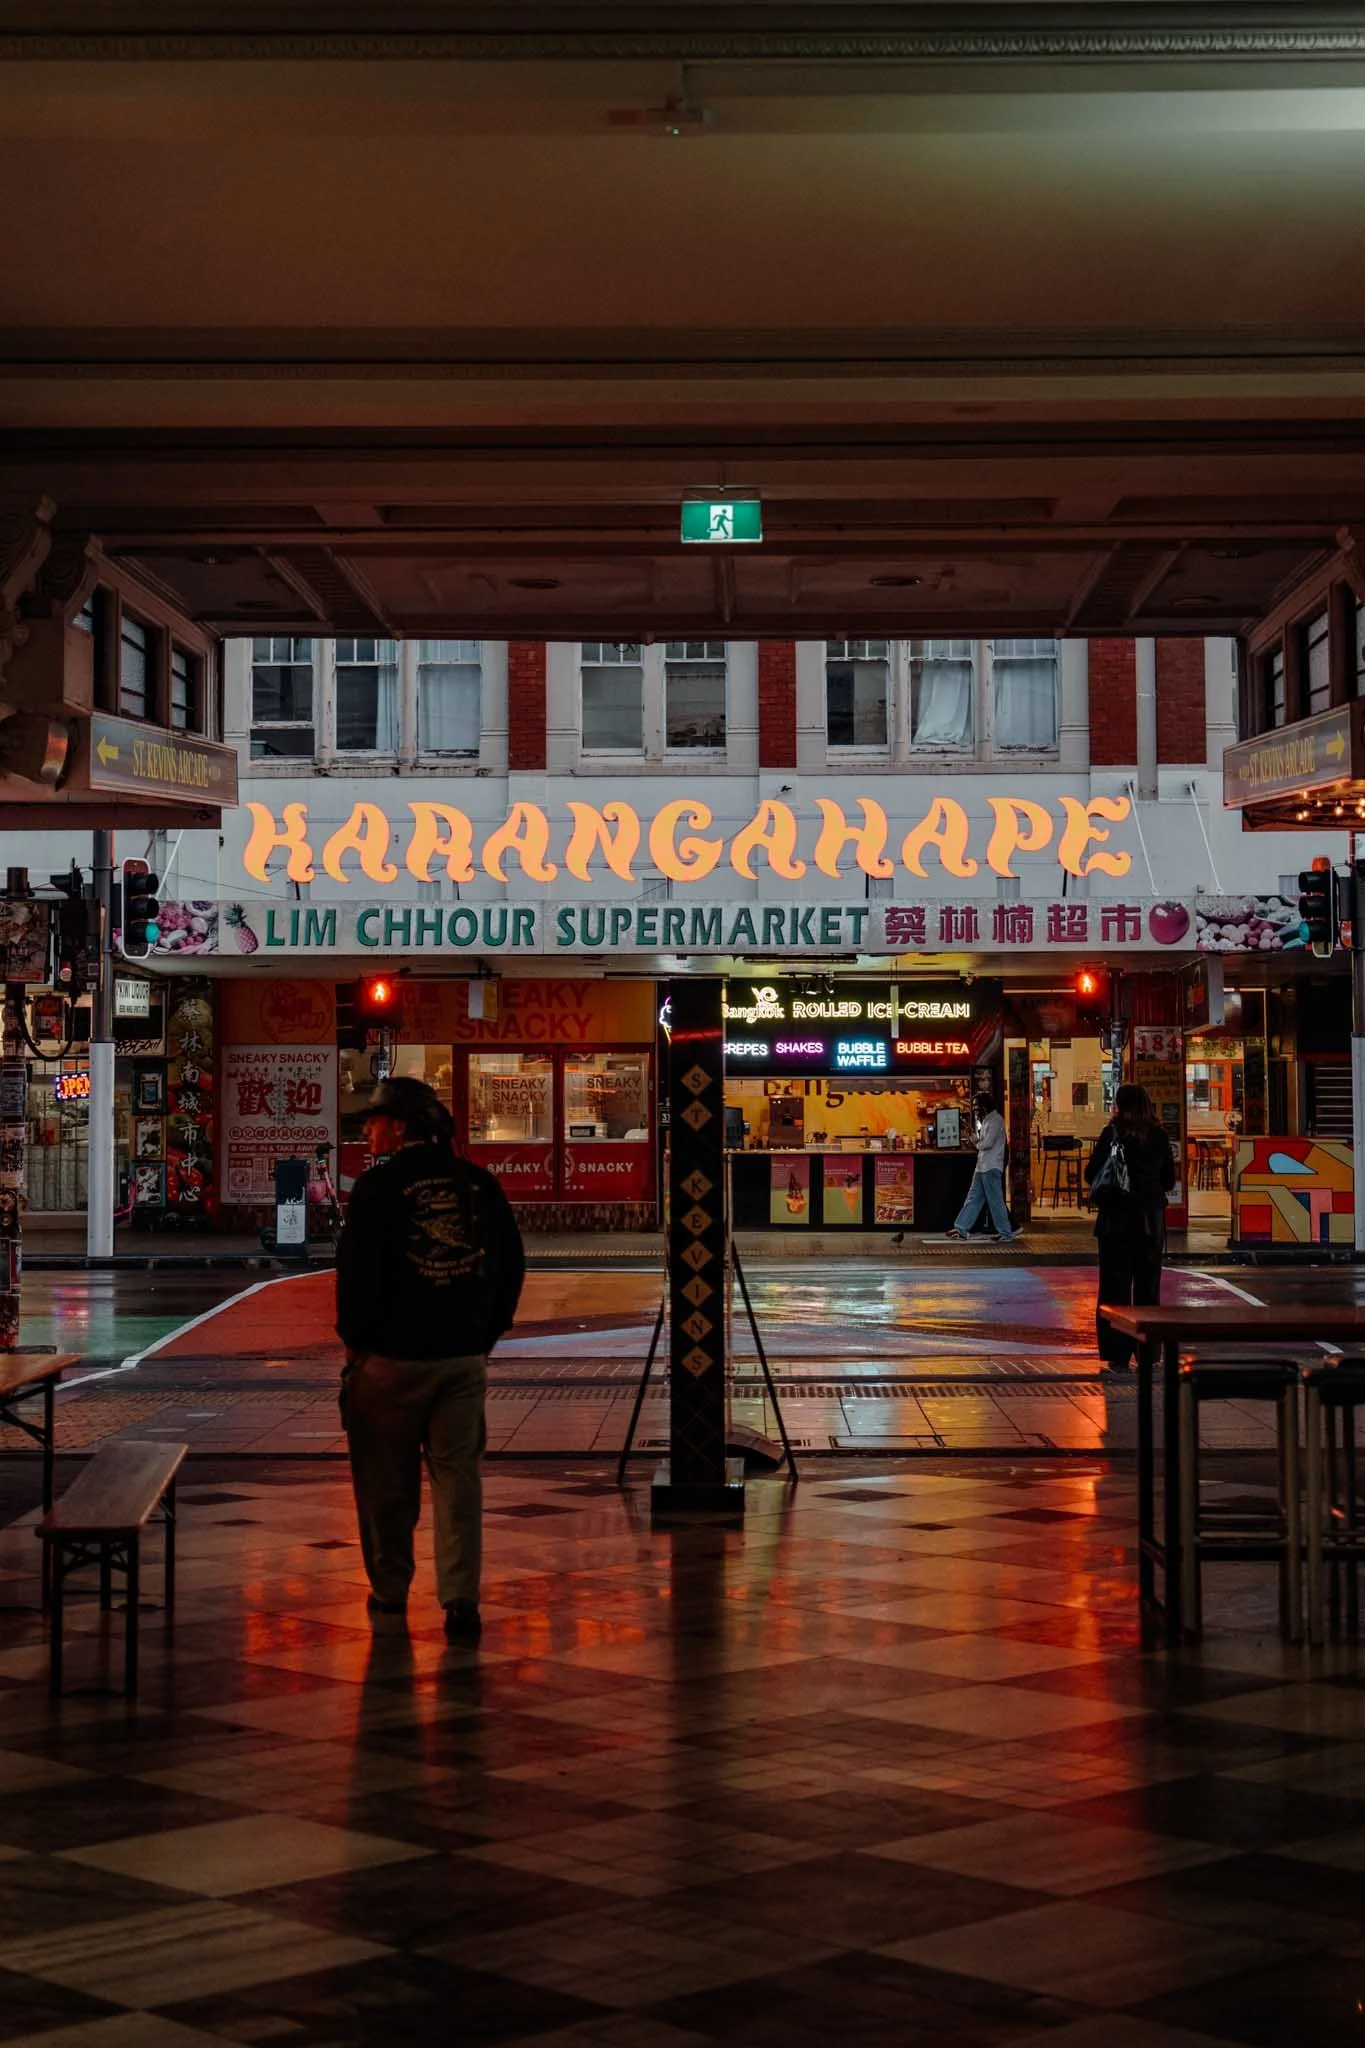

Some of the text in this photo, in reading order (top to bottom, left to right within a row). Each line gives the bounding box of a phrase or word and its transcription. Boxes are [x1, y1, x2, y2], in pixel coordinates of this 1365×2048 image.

[178, 750, 209, 788] ARCADE
[243, 796, 1132, 883] KARANGAHAPE
[265, 906, 869, 946] LIM CHHOUR SUPERMARKET
[885, 903, 1142, 945] 蔡林楠超市
[456, 982, 592, 1009] SEAKY
[792, 1001, 862, 1018] ROLLED
[456, 1013, 592, 1040] SNACKY
[775, 1042, 824, 1054] SHAKES
[837, 1042, 886, 1054] BUBBLE
[896, 1042, 970, 1055] BUBBLE TEA
[229, 1053, 329, 1064] SNEAKY SNACKY
[837, 1055, 887, 1067] WAFFLE
[492, 1078, 546, 1090] SNEAKY
[587, 1077, 642, 1089] SNEAKY
[492, 1091, 547, 1102] SNACKY
[486, 1161, 541, 1174] SNEAKY
[578, 1161, 634, 1174] SNACKY
